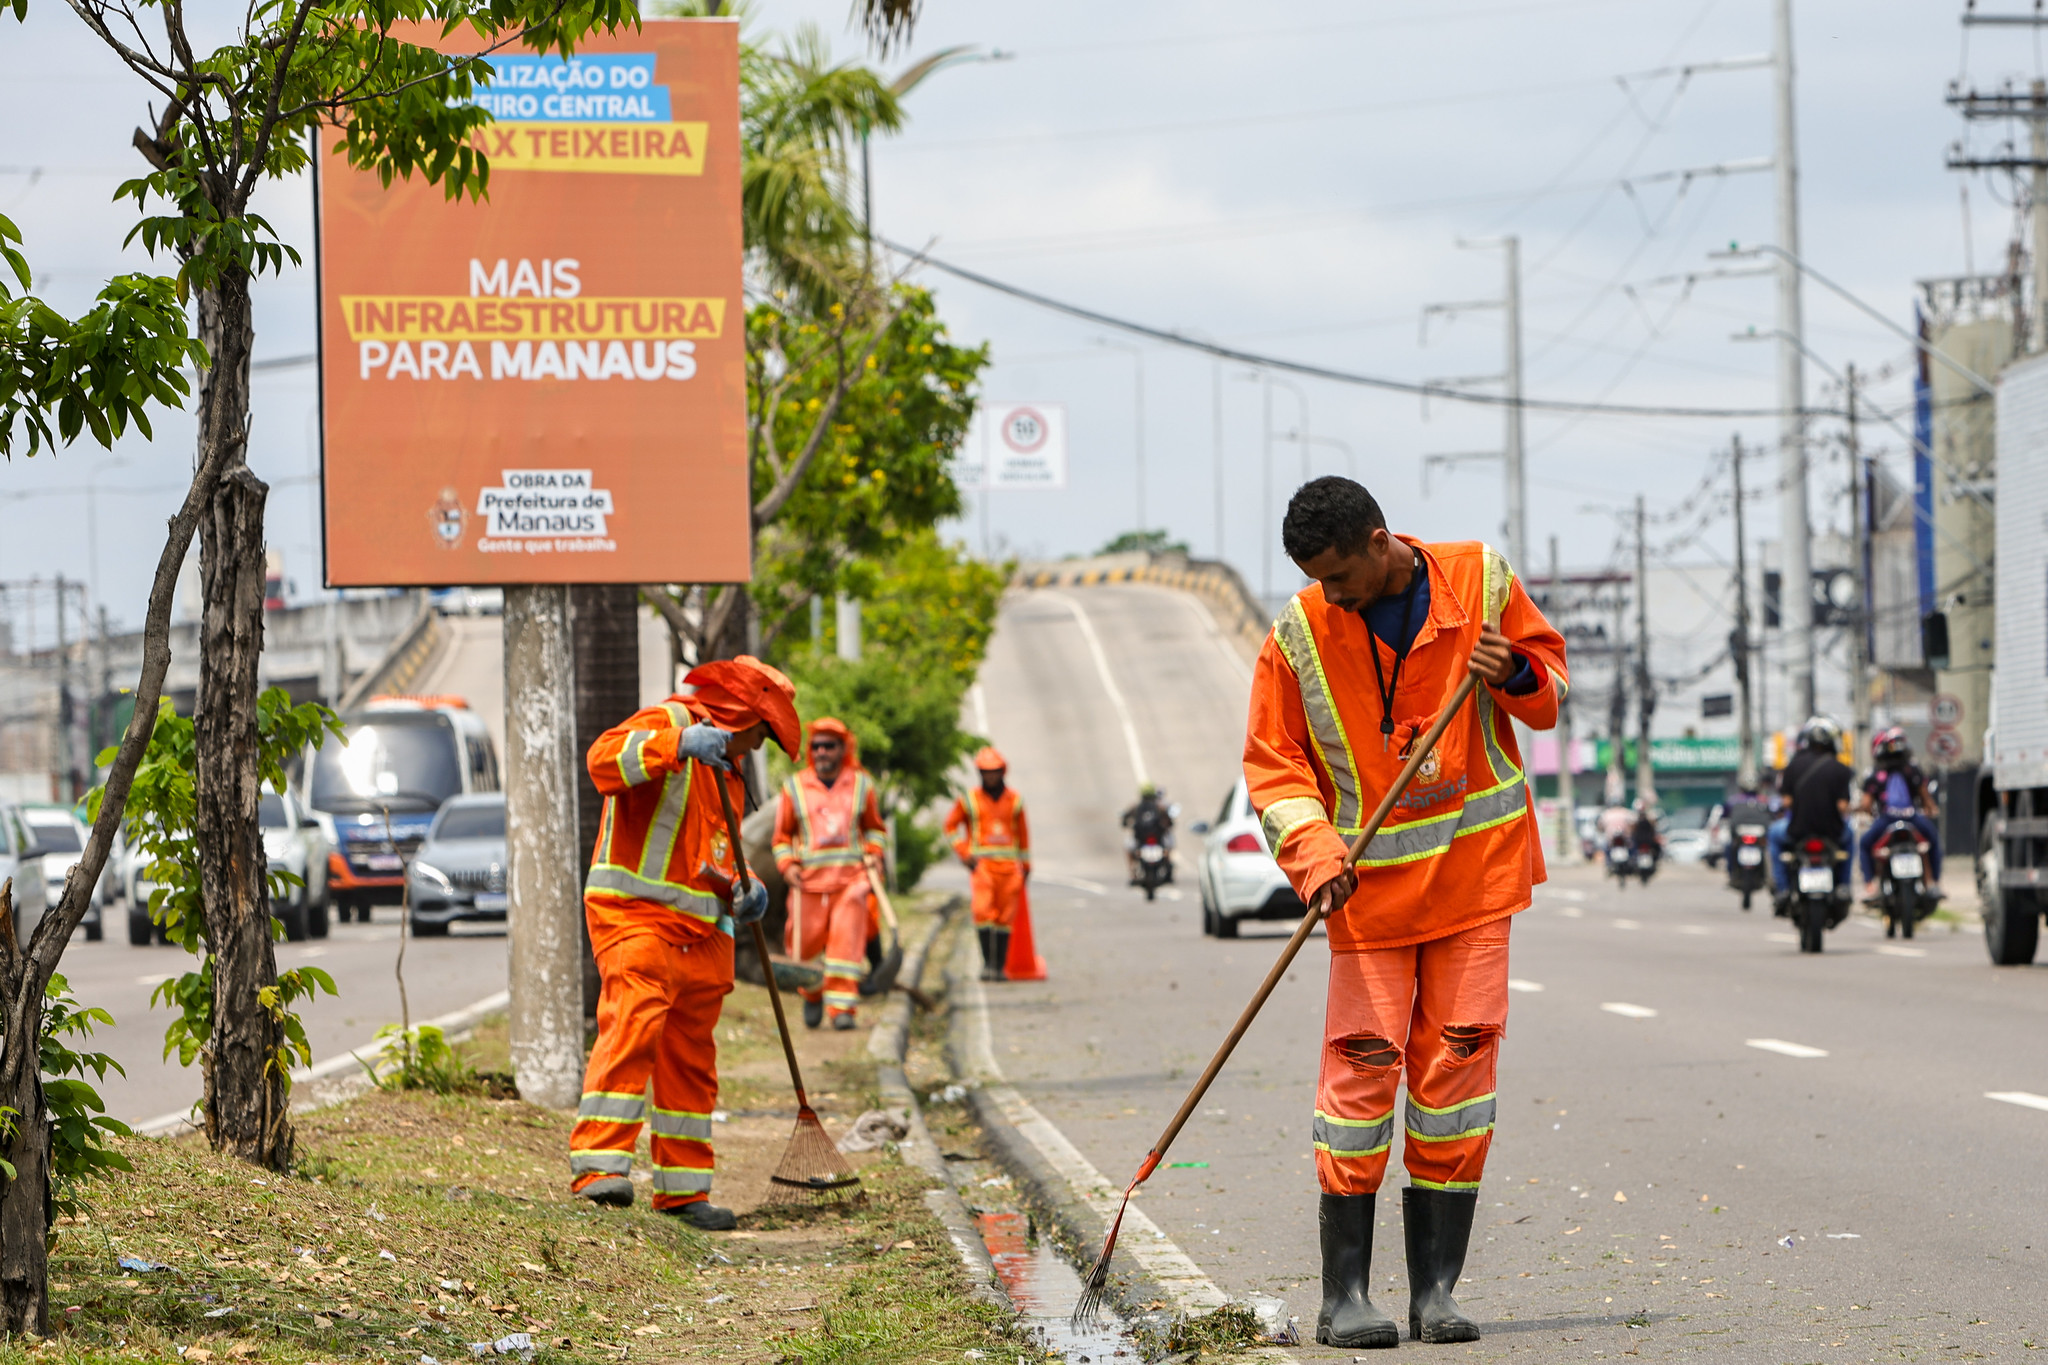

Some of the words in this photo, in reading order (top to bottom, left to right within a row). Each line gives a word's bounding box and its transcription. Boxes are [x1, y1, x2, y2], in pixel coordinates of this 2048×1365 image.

[470, 60, 604, 94] ALIZAÇÃO
[610, 65, 649, 89] DO
[543, 94, 655, 118] CENTRAL
[459, 129, 517, 158] AX
[525, 128, 693, 158] TEIXEIRA
[469, 258, 581, 299] MAIS
[353, 301, 717, 334] INFRAESTRUTURA
[360, 340, 483, 380] PARA
[491, 340, 697, 381] MANAUS
[509, 474, 557, 488] OBRA
[562, 474, 586, 487] DA
[485, 494, 577, 508] Prefeitura
[582, 495, 605, 508] de
[498, 512, 595, 531] Manaus
[477, 538, 523, 552] Gente
[525, 541, 553, 555] que
[555, 537, 617, 552] trabalha
